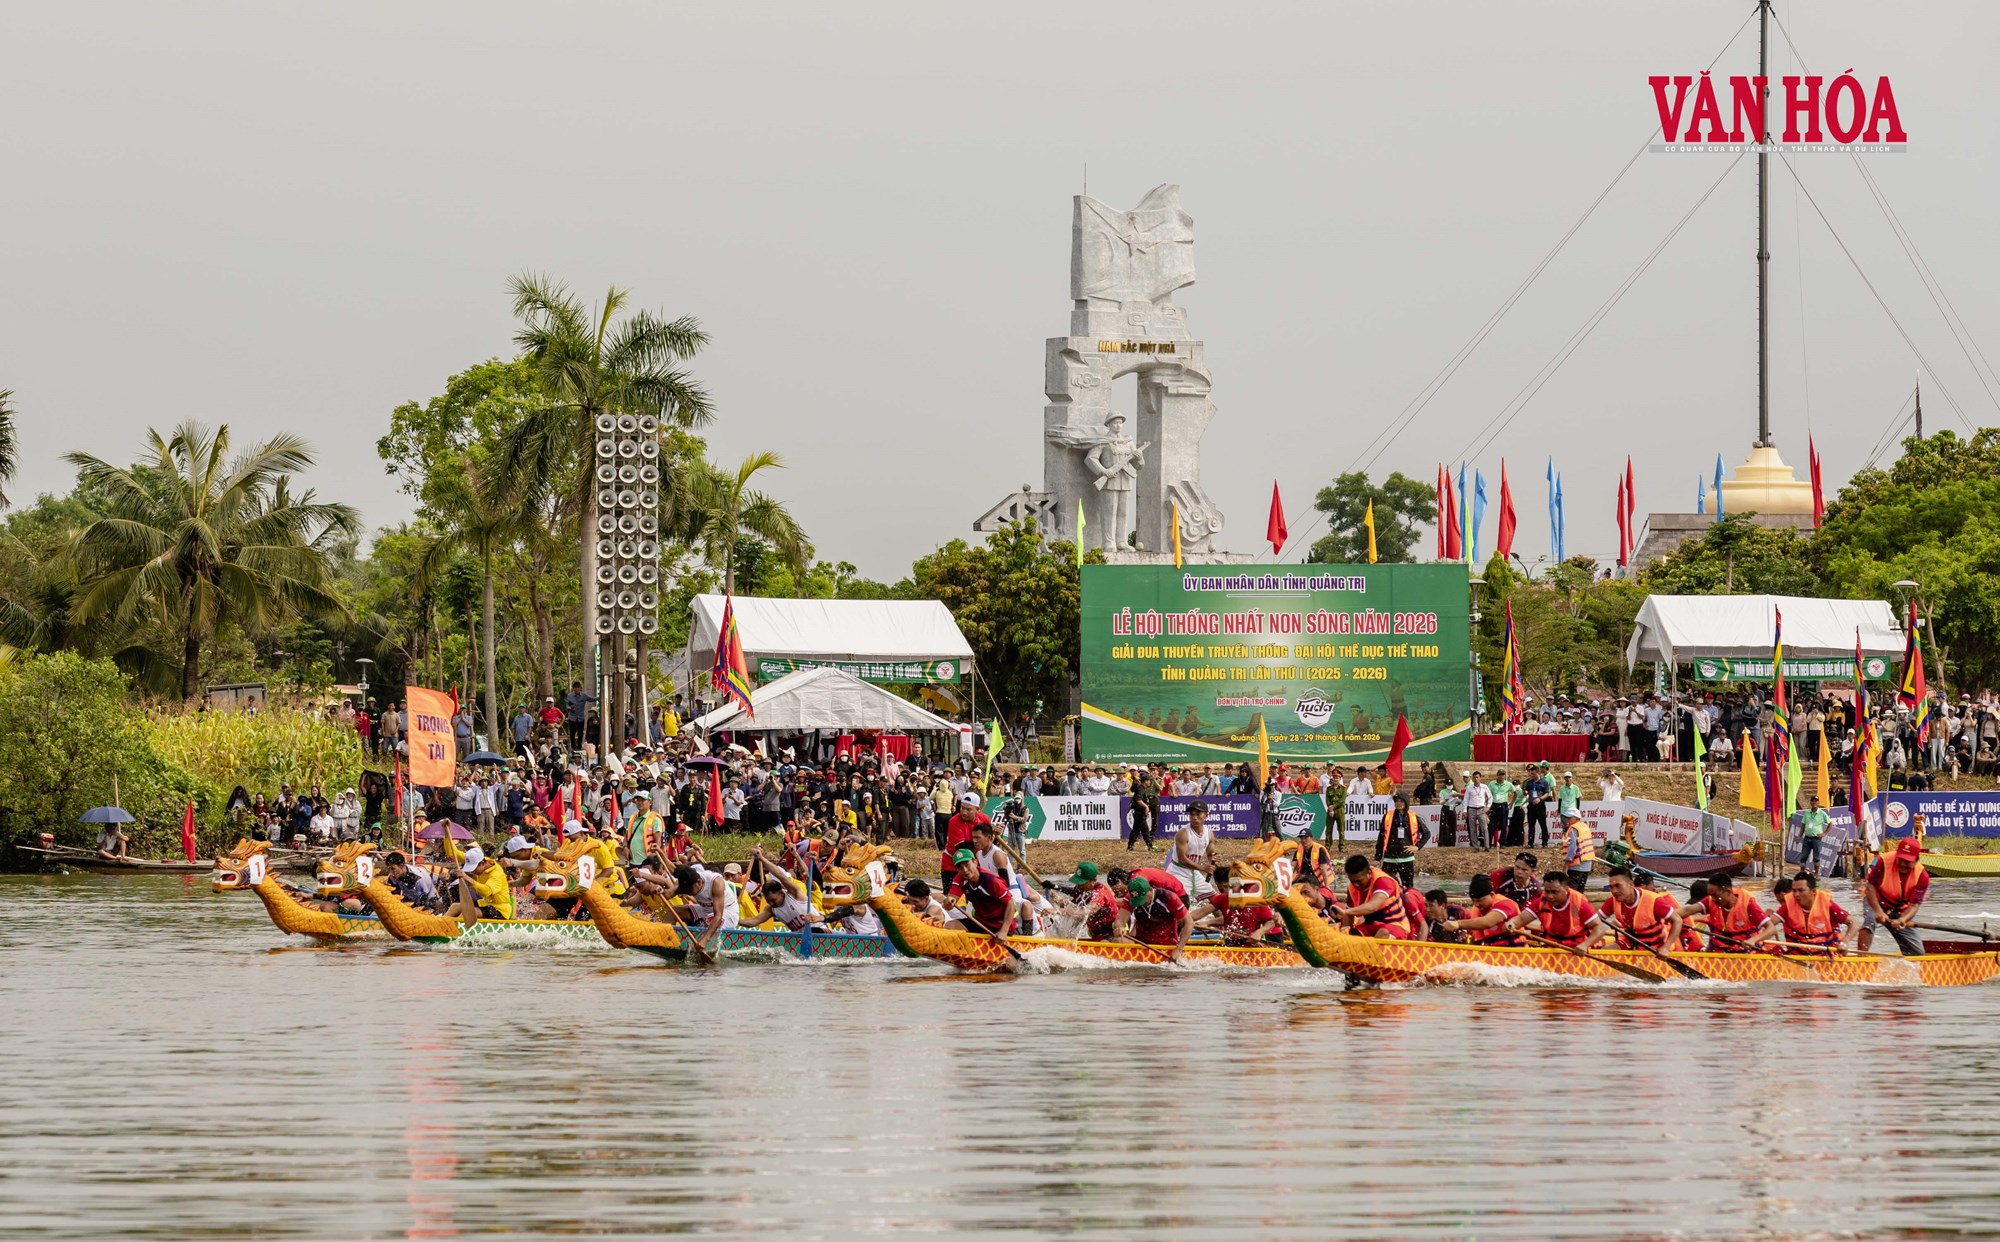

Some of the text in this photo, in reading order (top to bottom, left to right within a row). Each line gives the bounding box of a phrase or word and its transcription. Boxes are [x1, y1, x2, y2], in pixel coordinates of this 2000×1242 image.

[1098, 340, 1119, 353] NAM
[1184, 574, 1366, 593] ỦY BAN NHÂN DÂN TỈNH QUẢNG TRỊ
[1112, 607, 1438, 639] LỄ HỘI THỐNG NHẤT NON SÔNG NĂM 2026
[1112, 643, 1134, 659] GIẢI
[1138, 646, 1160, 659] ĐUA
[1252, 642, 1289, 658] THỐNG
[1295, 645, 1314, 660] ĐẠI
[1316, 643, 1336, 660] HỘI
[1338, 642, 1360, 658] THỂ
[1362, 645, 1384, 660] DỤC
[1387, 642, 1408, 658] THỂ
[1410, 645, 1439, 658] THAO
[1161, 664, 1186, 681] TỈNH
[1189, 664, 1227, 681] QUẢNG
[1230, 668, 1248, 682] TRỊ
[1274, 664, 1297, 680] THỨ
[1306, 666, 1342, 681] (2025
[1352, 666, 1388, 681] 2026)
[1217, 697, 1231, 706] ĐƠN
[1295, 698, 1334, 719] huda
[416, 714, 450, 736] TRỌNG
[1230, 734, 1256, 742] Quảng
[1270, 734, 1288, 742] ngày
[1290, 734, 1300, 742] 28
[1304, 734, 1314, 742] 29
[1315, 733, 1336, 742] tháng
[1338, 734, 1343, 742] 4
[1345, 734, 1361, 742] năm
[1362, 734, 1380, 742] 2026
[428, 741, 445, 760] TÀI
[1060, 801, 1106, 818] ĐẬM TÌNH
[1160, 804, 1172, 814] ĐẠI
[1174, 803, 1186, 814] HỘI
[1218, 801, 1232, 811] THỂ
[1233, 803, 1251, 811] THAO
[1368, 800, 1388, 815] TÌNH
[1600, 810, 1615, 818] THAO
[1919, 800, 1943, 813] KHỎE
[1945, 799, 1957, 813] ĐỂ
[1959, 801, 1976, 813] XÂY
[1054, 817, 1112, 831] MIỀN TRUNG
[1178, 813, 1191, 822] TỈN
[1222, 814, 1234, 822] TRỊ
[1344, 816, 1381, 831] IỀN TRU
[1646, 811, 1660, 824] KHỎE
[1669, 816, 1678, 830] LẬP
[1679, 819, 1699, 833] NGHIỆP
[1933, 814, 1951, 827] BẢO
[1953, 816, 1964, 830] VỆ
[1966, 813, 1978, 827] TỔ
[1227, 824, 1247, 832] 2026)
[1655, 828, 1662, 840] VÀ
[255, 862, 261, 877] 1
[361, 862, 370, 879] 2
[583, 862, 591, 880] 3
[1278, 861, 1290, 890] 5
[874, 870, 882, 887] 4
